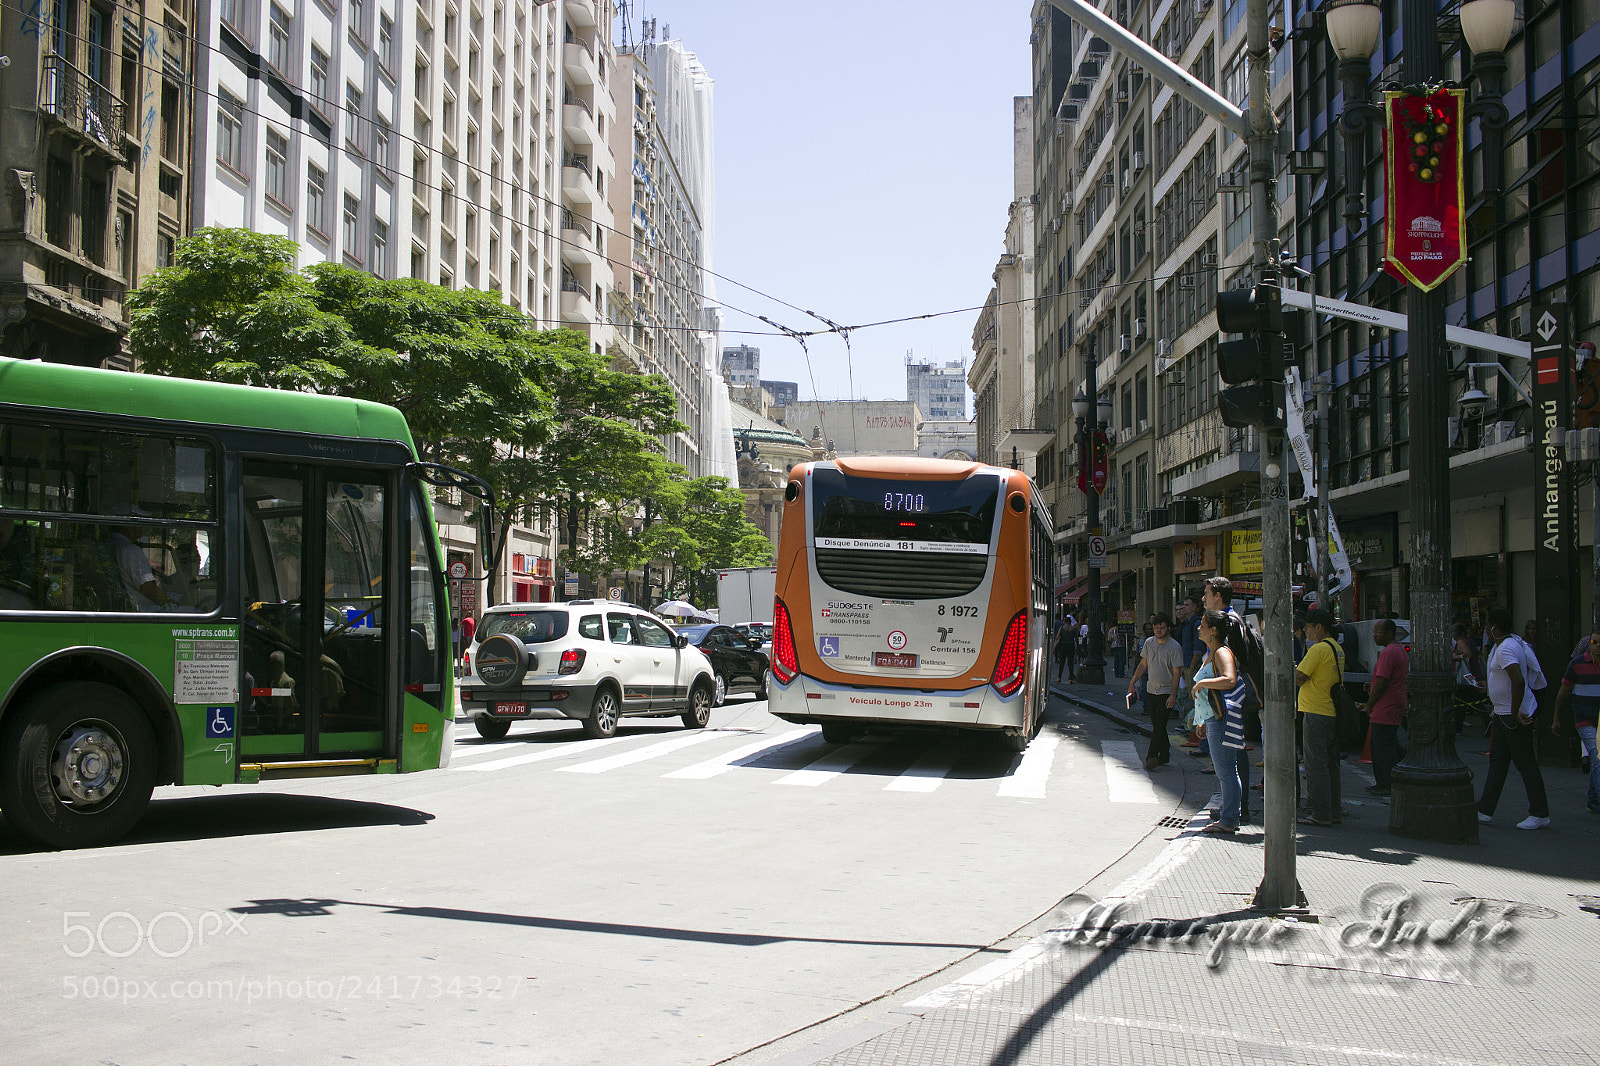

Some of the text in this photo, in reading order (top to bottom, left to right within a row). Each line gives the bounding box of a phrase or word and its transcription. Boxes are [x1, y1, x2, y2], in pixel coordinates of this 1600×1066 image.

[884, 493, 924, 512] 8700
[824, 539, 850, 547] Disque
[897, 542, 914, 550] 181
[828, 602, 874, 610] SUDOESTE
[938, 605, 978, 617] 8 1972
[172, 628, 236, 638] www.sptrans.com.br
[850, 697, 932, 708] Veículo Longo 23m
